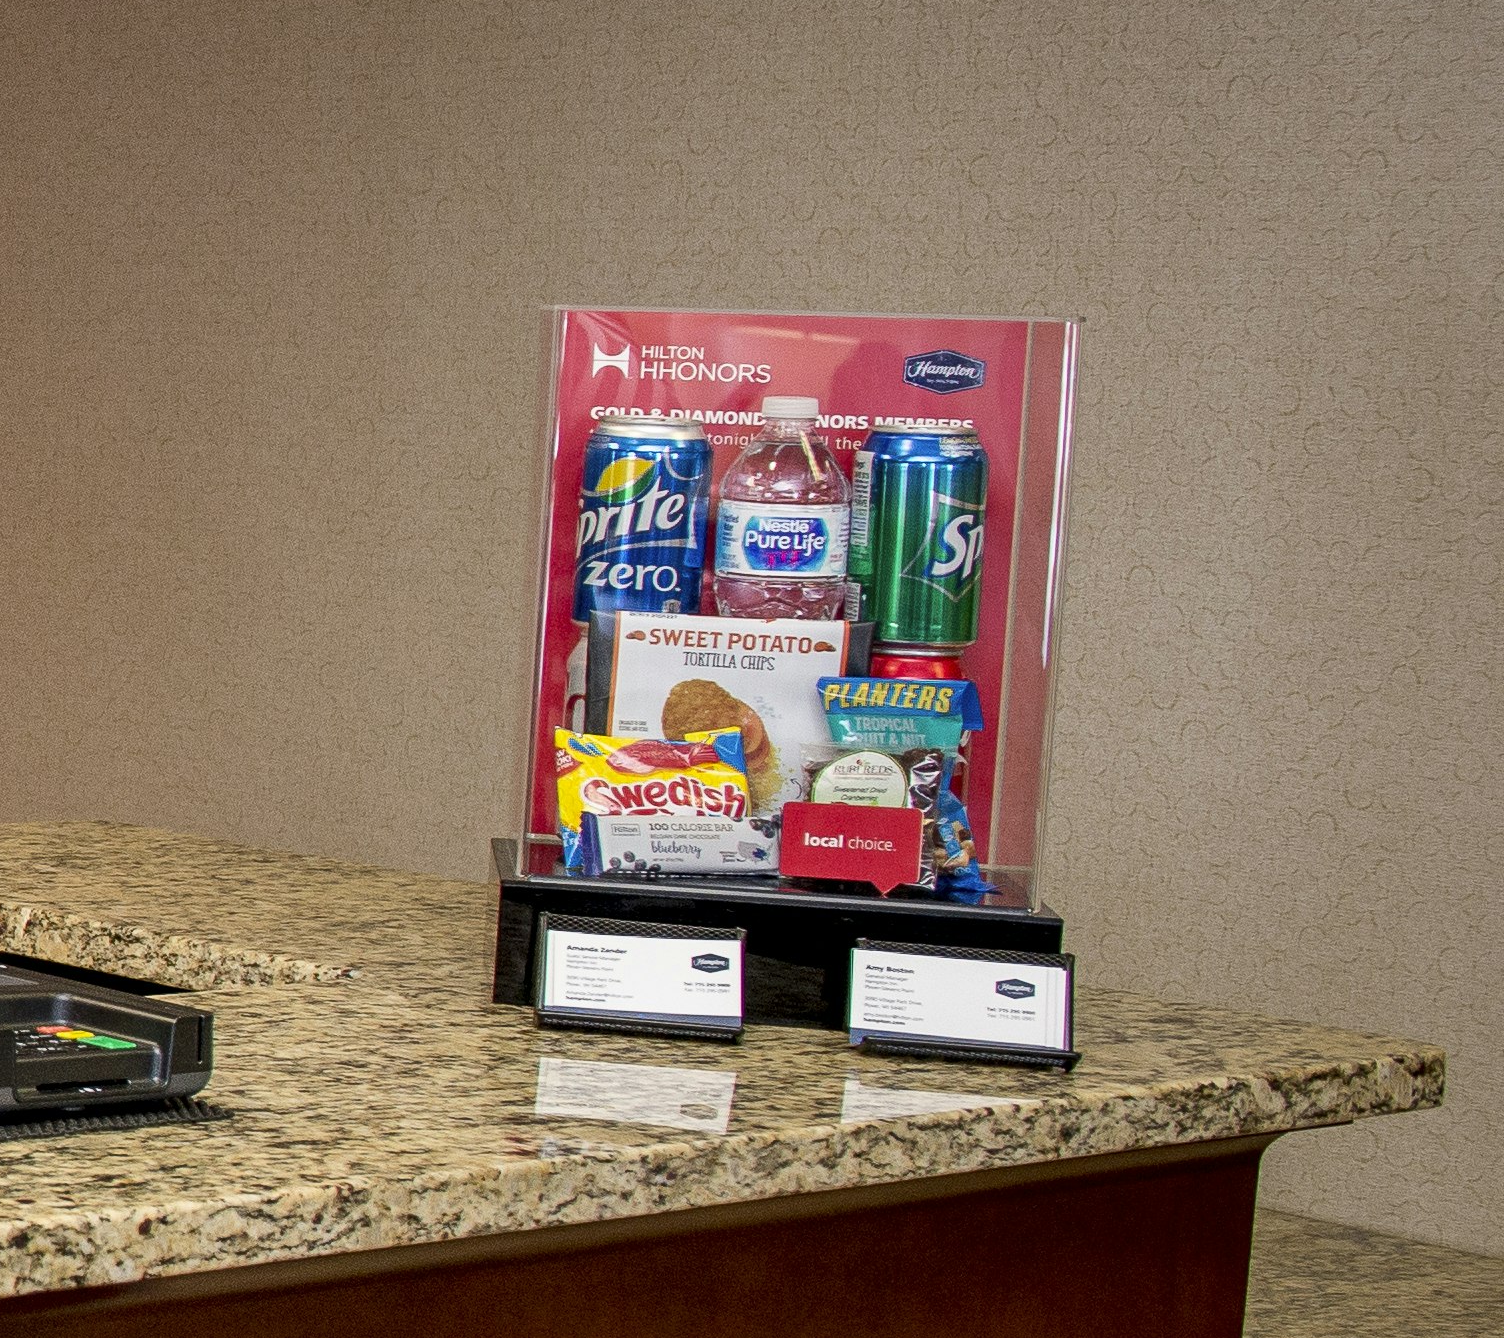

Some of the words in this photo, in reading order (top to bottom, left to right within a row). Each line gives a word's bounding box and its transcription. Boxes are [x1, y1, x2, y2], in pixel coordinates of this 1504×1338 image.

[641, 345, 705, 360] HILTON
[640, 361, 772, 384] HHONORS
[908, 361, 980, 378] Hampton
[671, 409, 767, 425] DIAMOND
[815, 415, 869, 429] NORS
[835, 436, 862, 450] the
[576, 476, 685, 559] prite
[745, 530, 791, 550] Pure
[793, 533, 826, 556] Life
[649, 628, 722, 647] SWEET
[728, 632, 813, 654] POTATO
[683, 651, 737, 669] TORTILLA
[741, 655, 775, 671] CHIPS
[824, 682, 954, 714] PLANTERS
[854, 716, 917, 732] TROPICAL
[583, 775, 746, 819] Swedish
[649, 823, 668, 831] 100
[671, 823, 713, 831] CALORIE
[715, 824, 734, 832] BAR
[651, 841, 702, 859] blueberry
[804, 832, 844, 848] local
